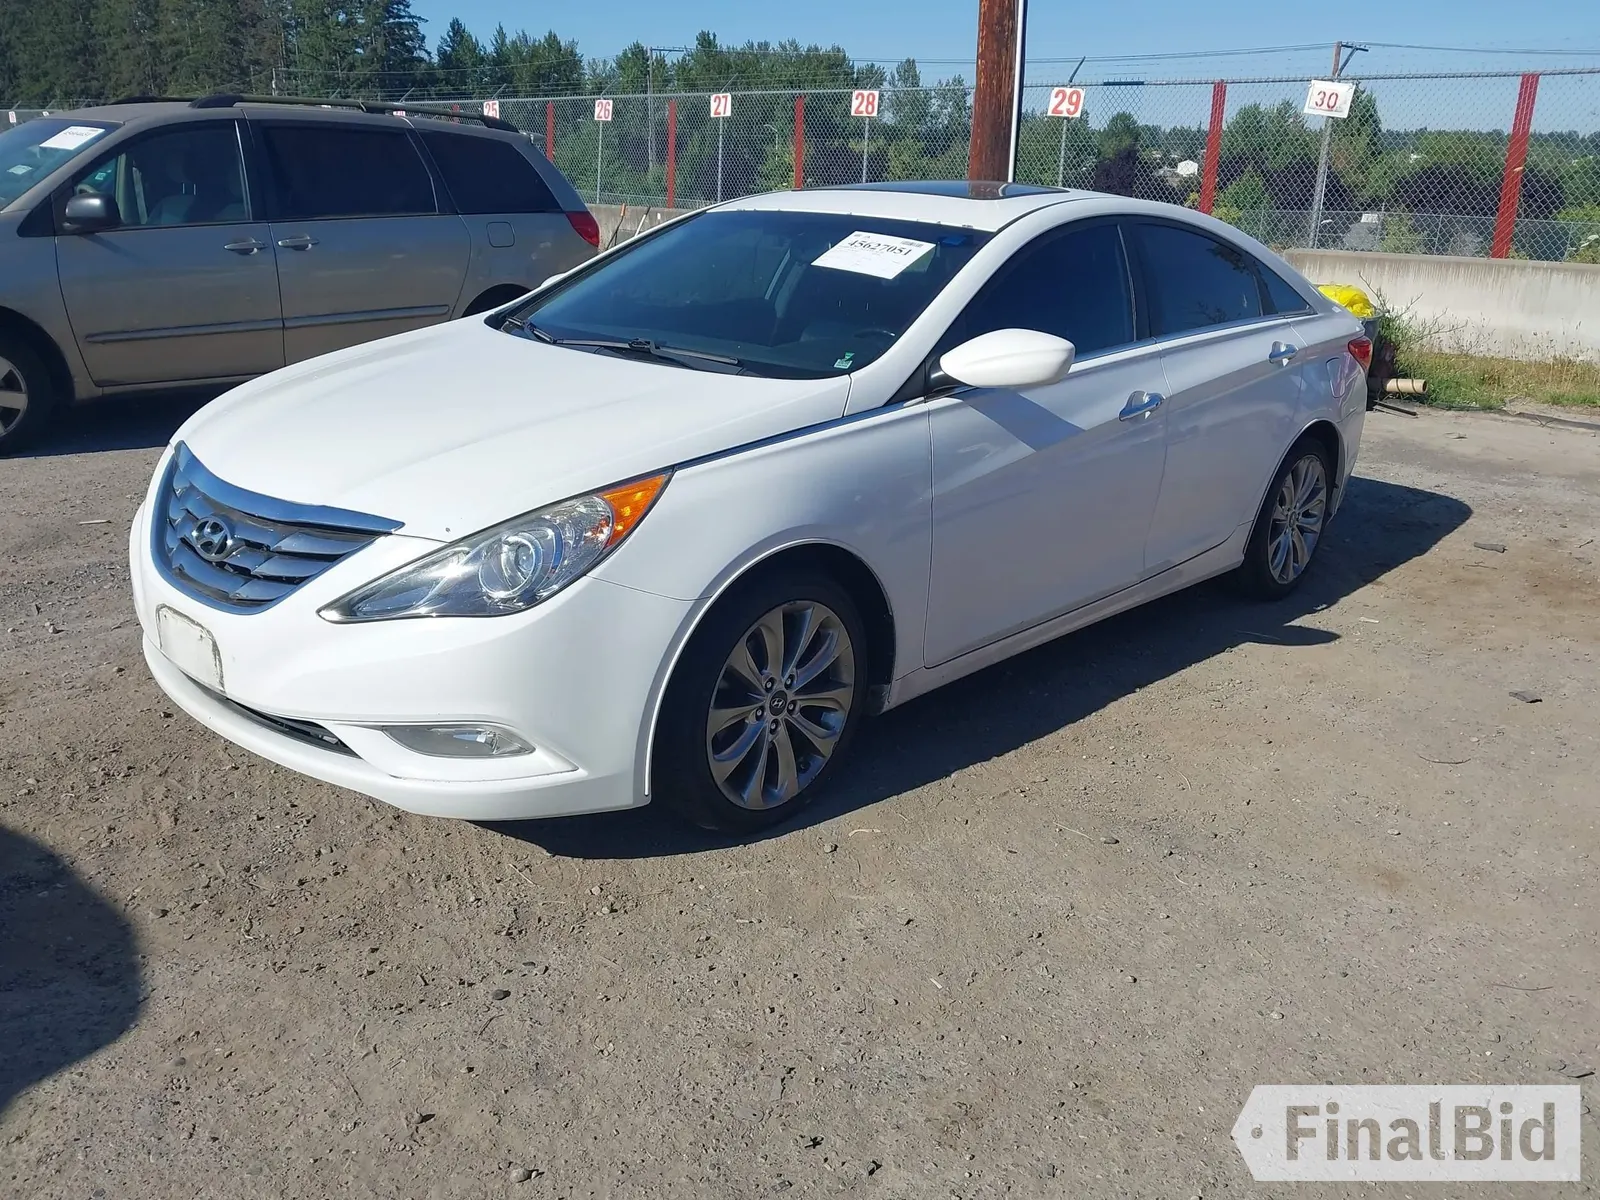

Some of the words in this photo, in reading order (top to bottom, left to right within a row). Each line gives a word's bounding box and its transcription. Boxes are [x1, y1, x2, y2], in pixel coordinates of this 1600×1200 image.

[713, 95, 729, 116] 27
[854, 92, 876, 115] 28
[1051, 89, 1081, 116] 29
[1315, 90, 1339, 109] 30
[485, 102, 498, 118] 25
[596, 101, 611, 119] 26
[848, 240, 912, 256] 45627051
